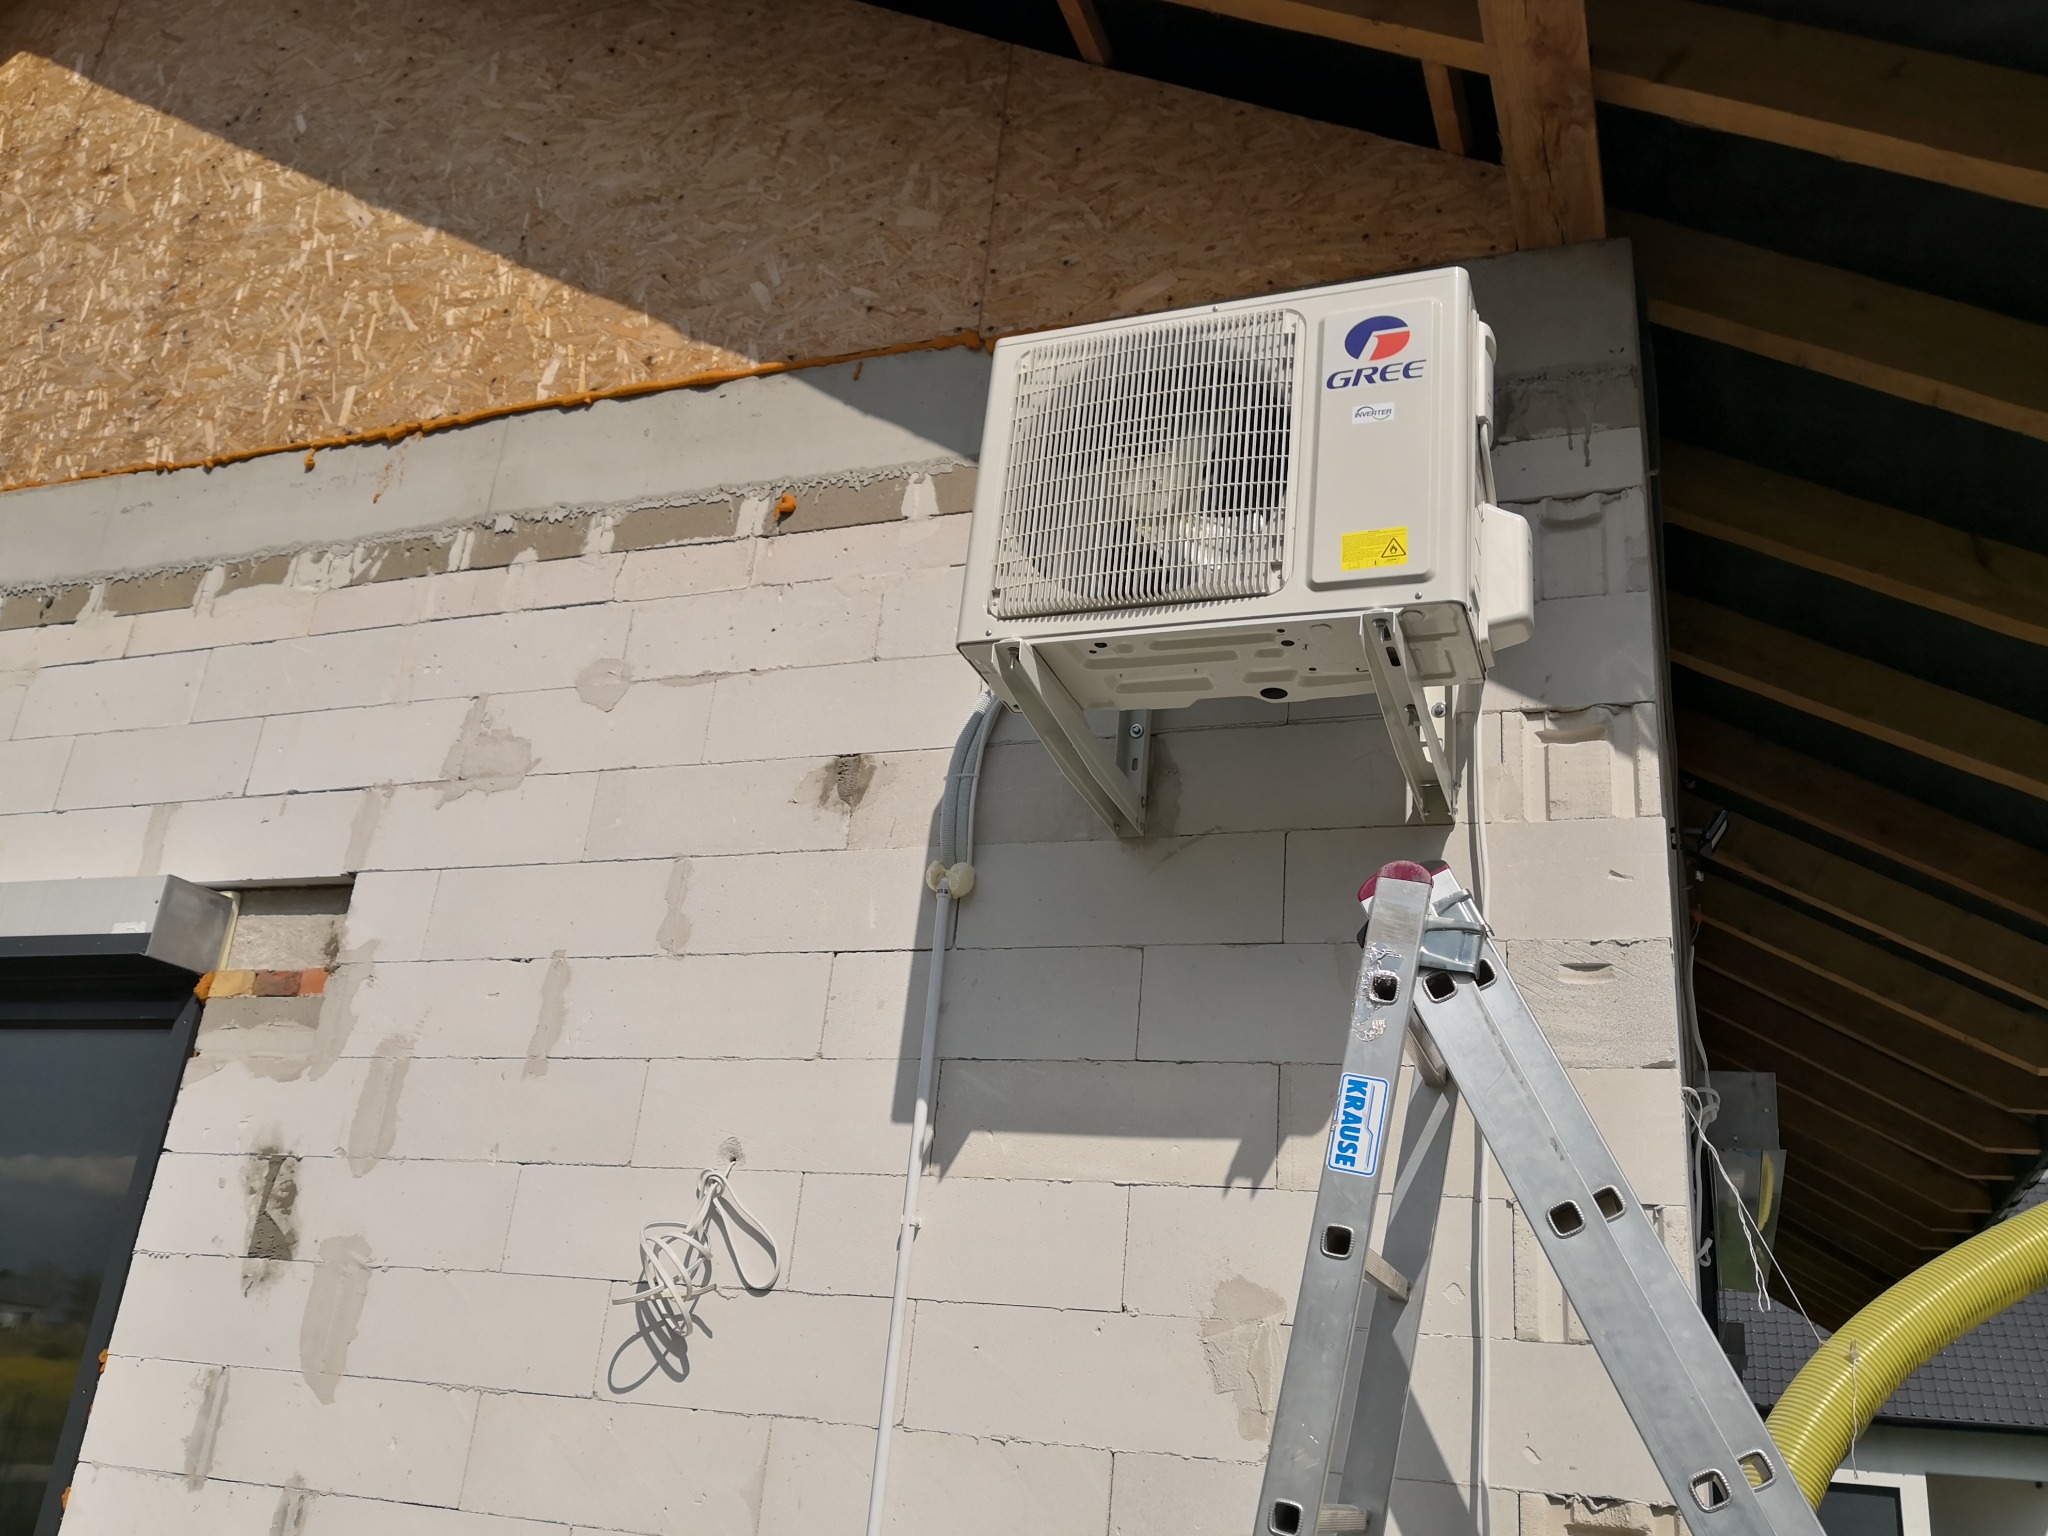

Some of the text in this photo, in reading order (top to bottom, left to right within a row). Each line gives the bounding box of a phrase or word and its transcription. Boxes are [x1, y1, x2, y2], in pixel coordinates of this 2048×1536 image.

[1326, 359, 1427, 389] GREE
[1354, 408, 1392, 418] INVERTER
[1335, 1079, 1368, 1167] KRAUSE
